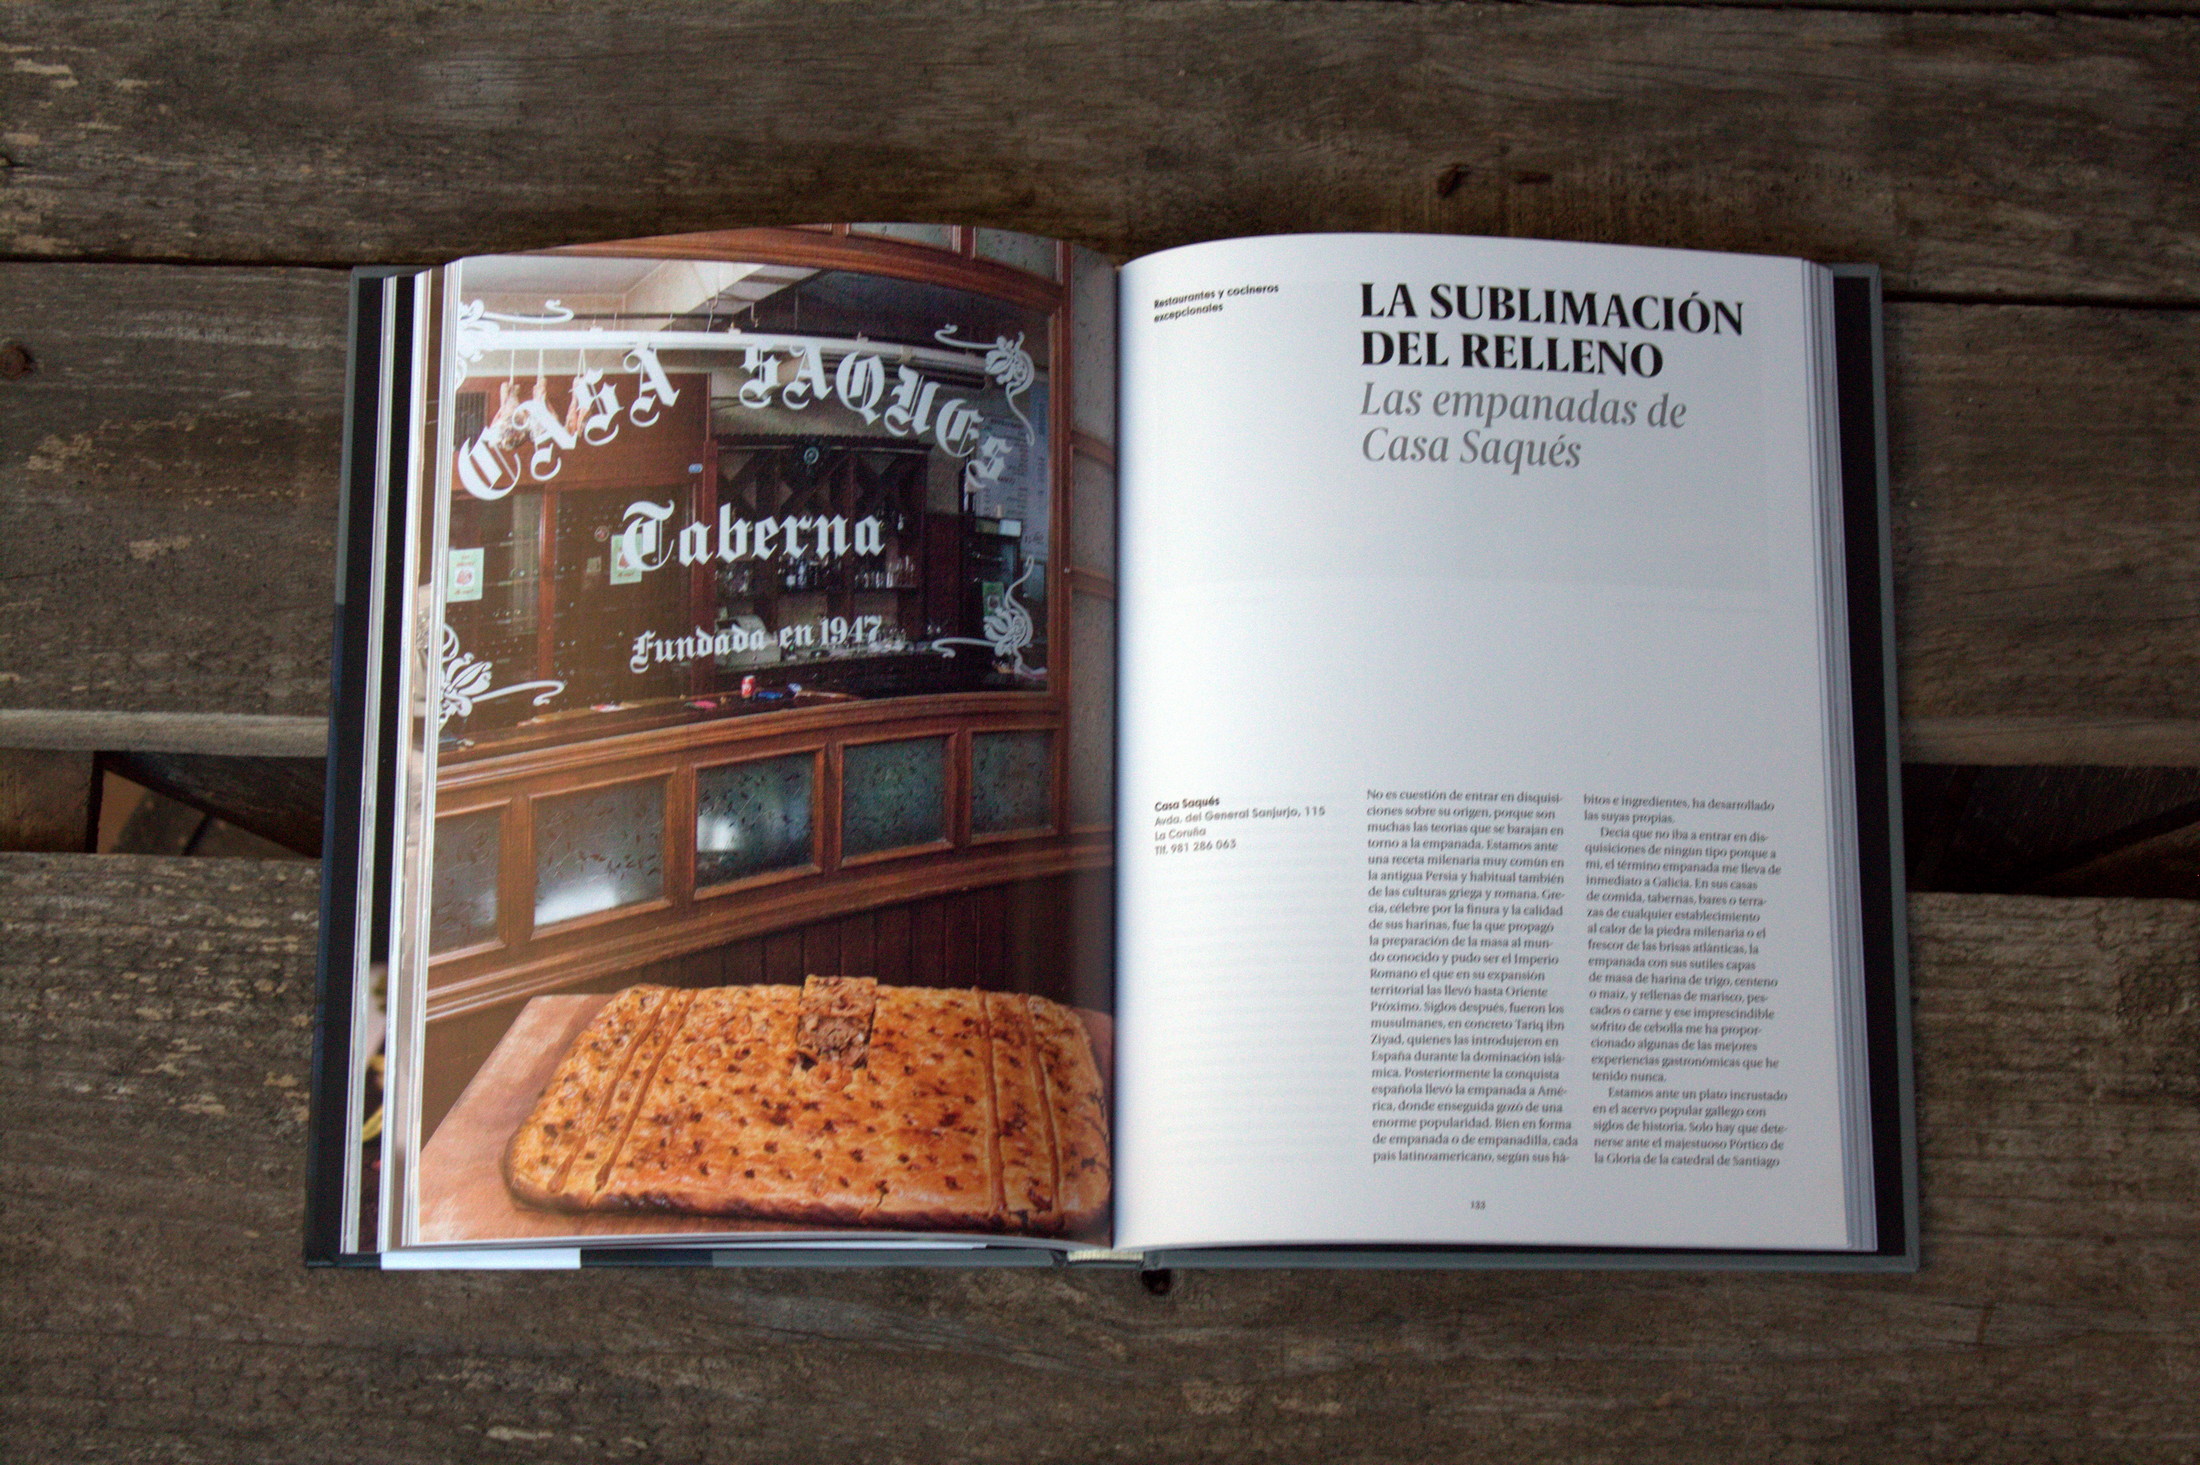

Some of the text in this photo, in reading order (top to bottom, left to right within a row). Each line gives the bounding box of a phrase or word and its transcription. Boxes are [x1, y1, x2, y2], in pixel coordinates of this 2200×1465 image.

[1154, 284, 1279, 309] Restaurantes y cocineros
[1154, 303, 1223, 322] excepcionales
[1361, 283, 1743, 335] LA SUBLIMACIÓN
[1361, 331, 1664, 378] DEL RELLENO
[1360, 382, 1687, 428] Las empanadas de
[458, 343, 680, 500] CASA
[1362, 426, 1582, 475] Casa Saqués
[622, 500, 885, 571] Taberna
[630, 615, 882, 674] Fundada en 1947
[1367, 789, 1384, 799] No
[1385, 791, 1397, 800] es
[1399, 790, 1447, 801] cuestión
[1449, 789, 1463, 801] de
[1465, 792, 1498, 802] entrar
[1501, 793, 1514, 802] en
[1584, 794, 1611, 805] bitos
[1613, 797, 1619, 806] e
[1692, 798, 1705, 809] ha
[1708, 798, 1774, 811] desarrollado
[1154, 796, 1220, 812] Casa Saqués
[1154, 806, 1326, 827] Avda. del General Sanjurjo, 115
[1367, 806, 1403, 816] ciones
[1405, 805, 1436, 816] sobre
[1438, 808, 1451, 817] su
[1494, 809, 1533, 821] porque
[1536, 811, 1555, 819] son
[1584, 809, 1599, 821] las
[1601, 813, 1630, 824] suyas
[1154, 827, 1207, 842] La Coruña
[1170, 843, 1189, 854] 981
[1193, 840, 1212, 851] 286
[1215, 839, 1236, 850] 063
[1368, 839, 1399, 848] torno
[1401, 840, 1408, 849] a
[1410, 837, 1420, 849] la
[1487, 839, 1532, 851] Estamos
[1534, 842, 1558, 852] ante
[1368, 854, 1564, 869] una receta milenaria muy común en
[1368, 869, 1564, 884] la antigua Persia y habitual también
[1587, 907, 1760, 922] zas de cualquier establecimiento
[1588, 923, 1766, 939] al calor de la piedra milenaria o el
[1369, 935, 1379, 946] la
[1382, 936, 1449, 949] preparación
[1451, 935, 1465, 947] de
[1468, 935, 1478, 947] la
[1480, 938, 1509, 948] masa
[1511, 937, 1521, 948] al
[1588, 956, 1756, 973] empanada con sus sutiles capas
[1370, 968, 1545, 983] Romano el que en su expansión
[1370, 984, 1548, 998] territorial las llevó hasta Oriente
[1590, 1004, 1621, 1016] cados
[1633, 1008, 1662, 1016] carne
[1665, 1009, 1671, 1020] y
[1674, 1009, 1691, 1017] ese
[1694, 1008, 1774, 1020] imprescindible
[1407, 1034, 1451, 1047] quienes
[1454, 1034, 1469, 1045] las
[1471, 1035, 1542, 1048] introdujeron
[1545, 1038, 1559, 1047] en
[1591, 1037, 1757, 1053] cionado algunas de las mejores
[1591, 1055, 1779, 1070] experiencias gastronómicas que he
[1608, 1087, 1788, 1102] Estamos ante un plato incrustado
[1593, 1103, 1766, 1119] en el acervo popular gallego con
[1372, 1119, 1417, 1128] enorme
[1495, 1117, 1520, 1129] Bien
[1522, 1120, 1536, 1129] en
[1539, 1118, 1572, 1129] forma
[1372, 1133, 1387, 1144] de
[1389, 1133, 1449, 1147] empanada
[1451, 1136, 1459, 1144] o
[1461, 1133, 1475, 1145] de
[1552, 1135, 1578, 1146] cada
